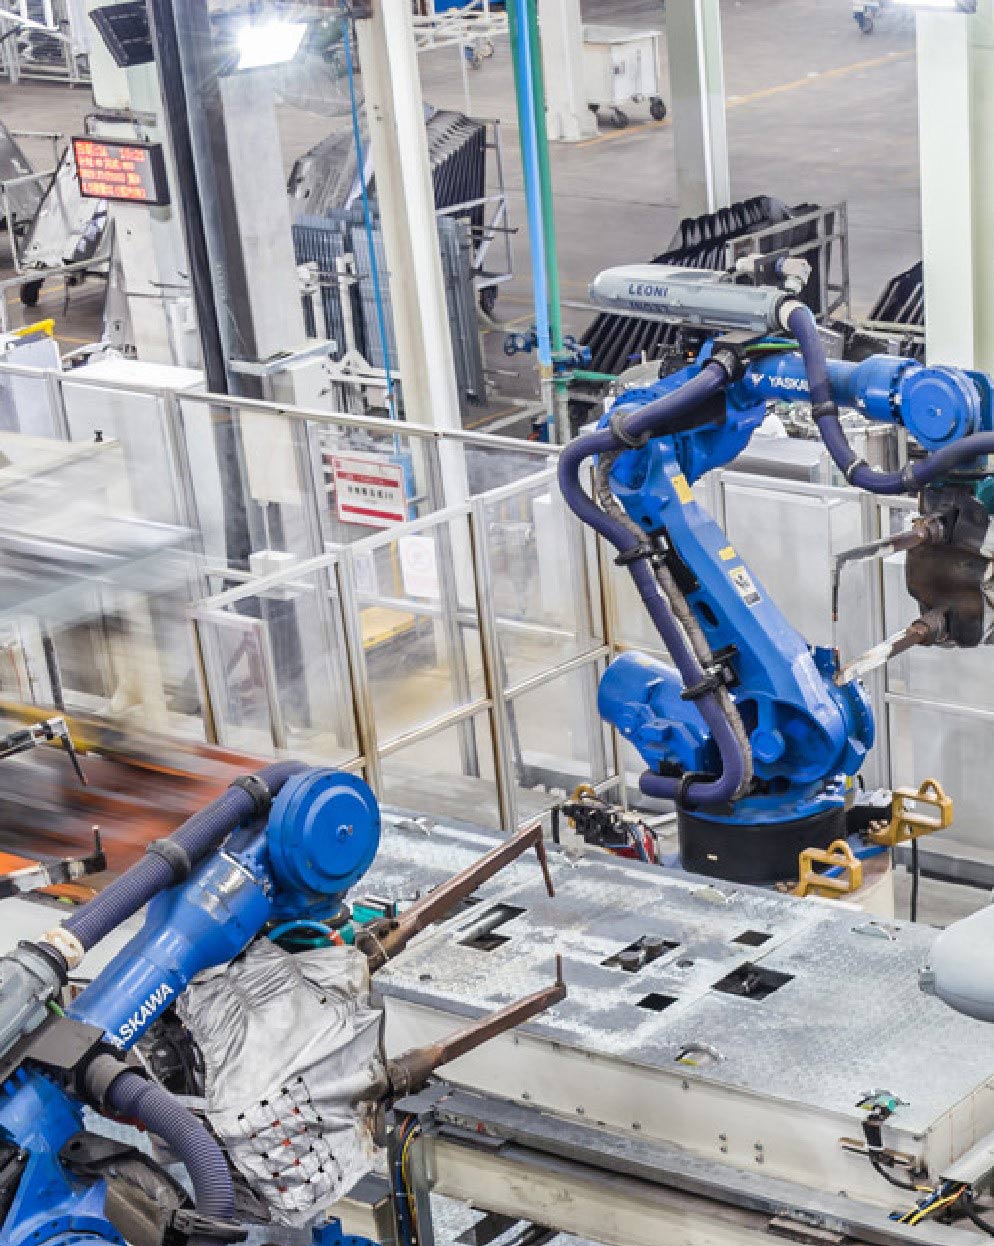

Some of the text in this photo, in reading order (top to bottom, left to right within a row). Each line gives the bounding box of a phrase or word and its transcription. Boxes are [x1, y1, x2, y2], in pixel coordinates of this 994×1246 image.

[628, 283, 669, 298] LEONI
[768, 375, 810, 392] YASKA
[110, 982, 175, 1052] ASKAWA
